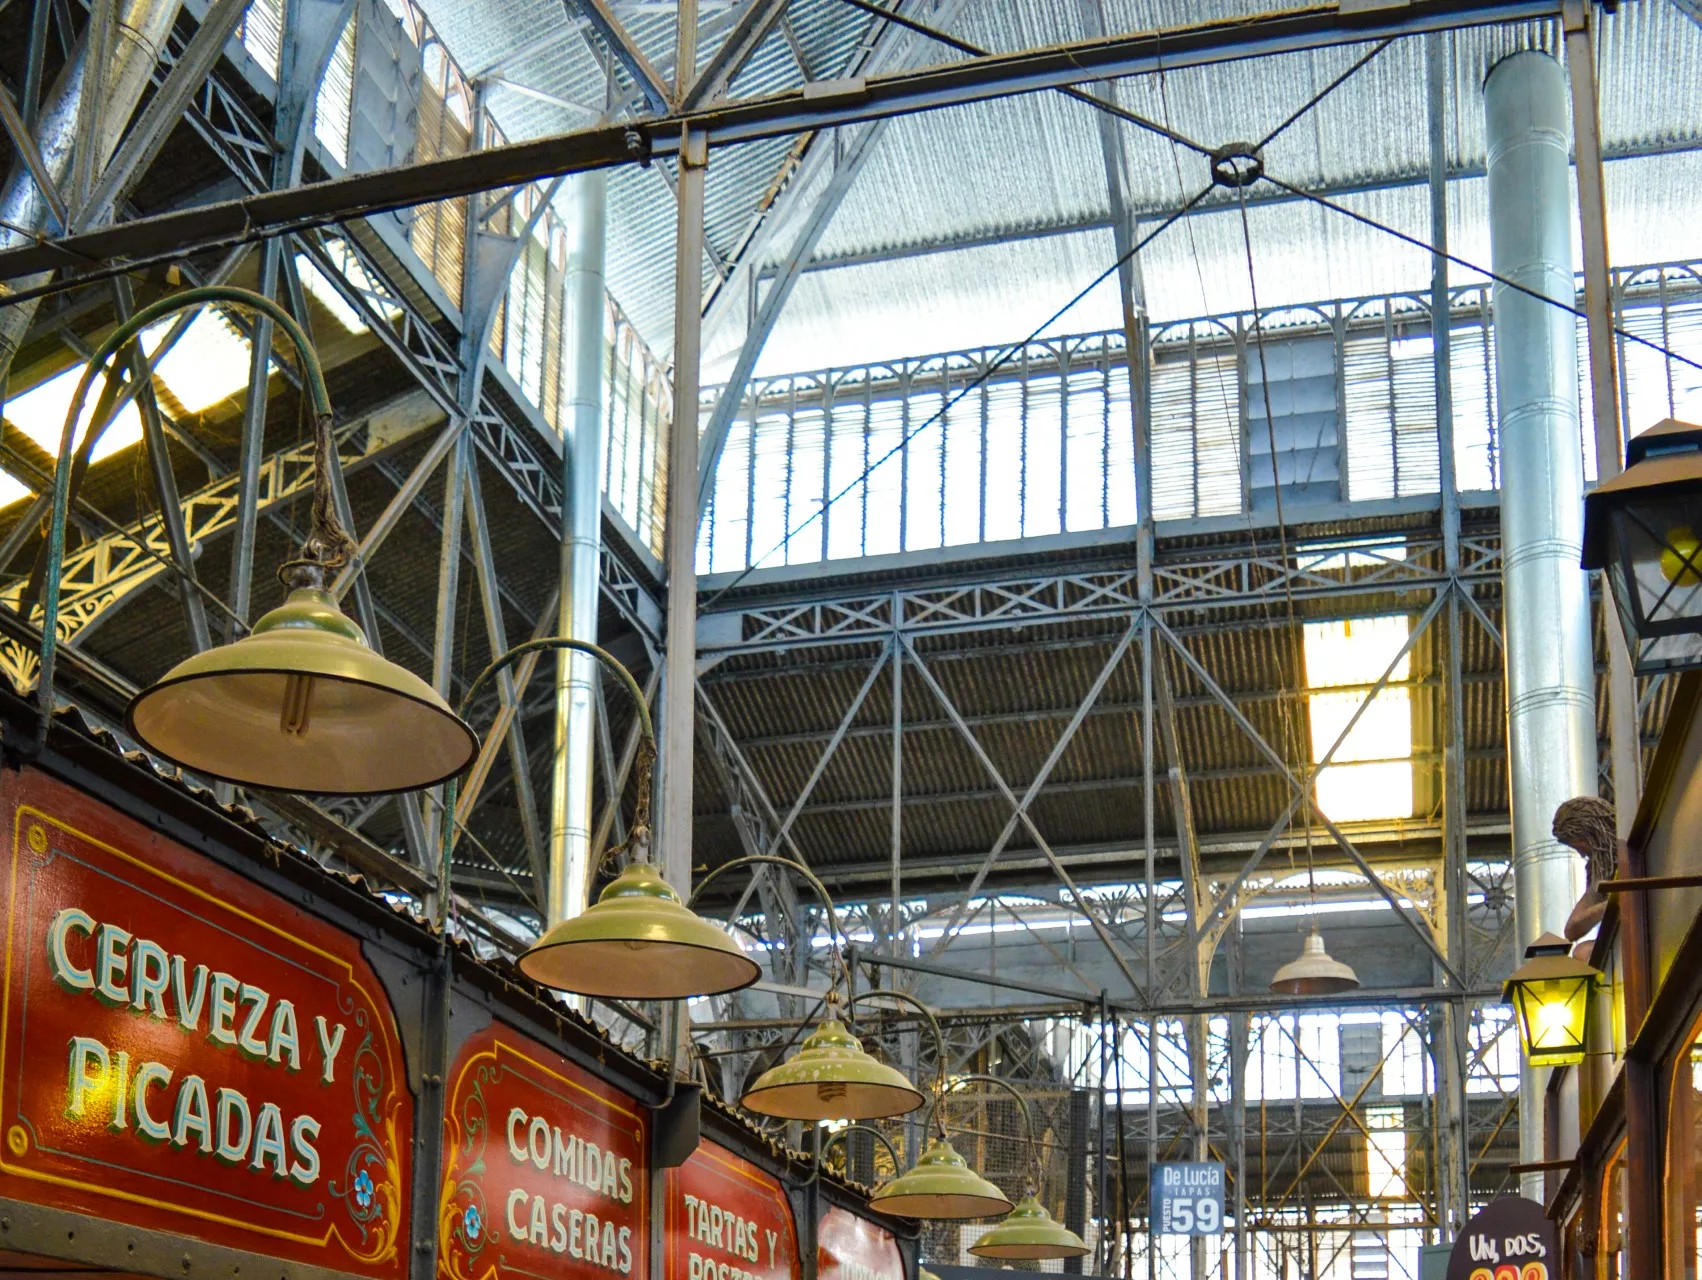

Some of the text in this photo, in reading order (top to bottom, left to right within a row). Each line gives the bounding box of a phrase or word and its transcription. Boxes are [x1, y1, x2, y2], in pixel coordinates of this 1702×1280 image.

[49, 908, 346, 1084] CERVEZA Y
[65, 1036, 322, 1184] PICADAS
[507, 1107, 633, 1204] COMIDAS
[1164, 1166, 1219, 1186] De Lucía
[1162, 1199, 1171, 1232] PUESTO
[1172, 1198, 1219, 1232] 59
[1174, 1188, 1211, 1196] TAPAS
[507, 1188, 632, 1273] CASERAS
[684, 1194, 777, 1270] TARTAS Y
[1469, 1233, 1547, 1263] UN, DOS,
